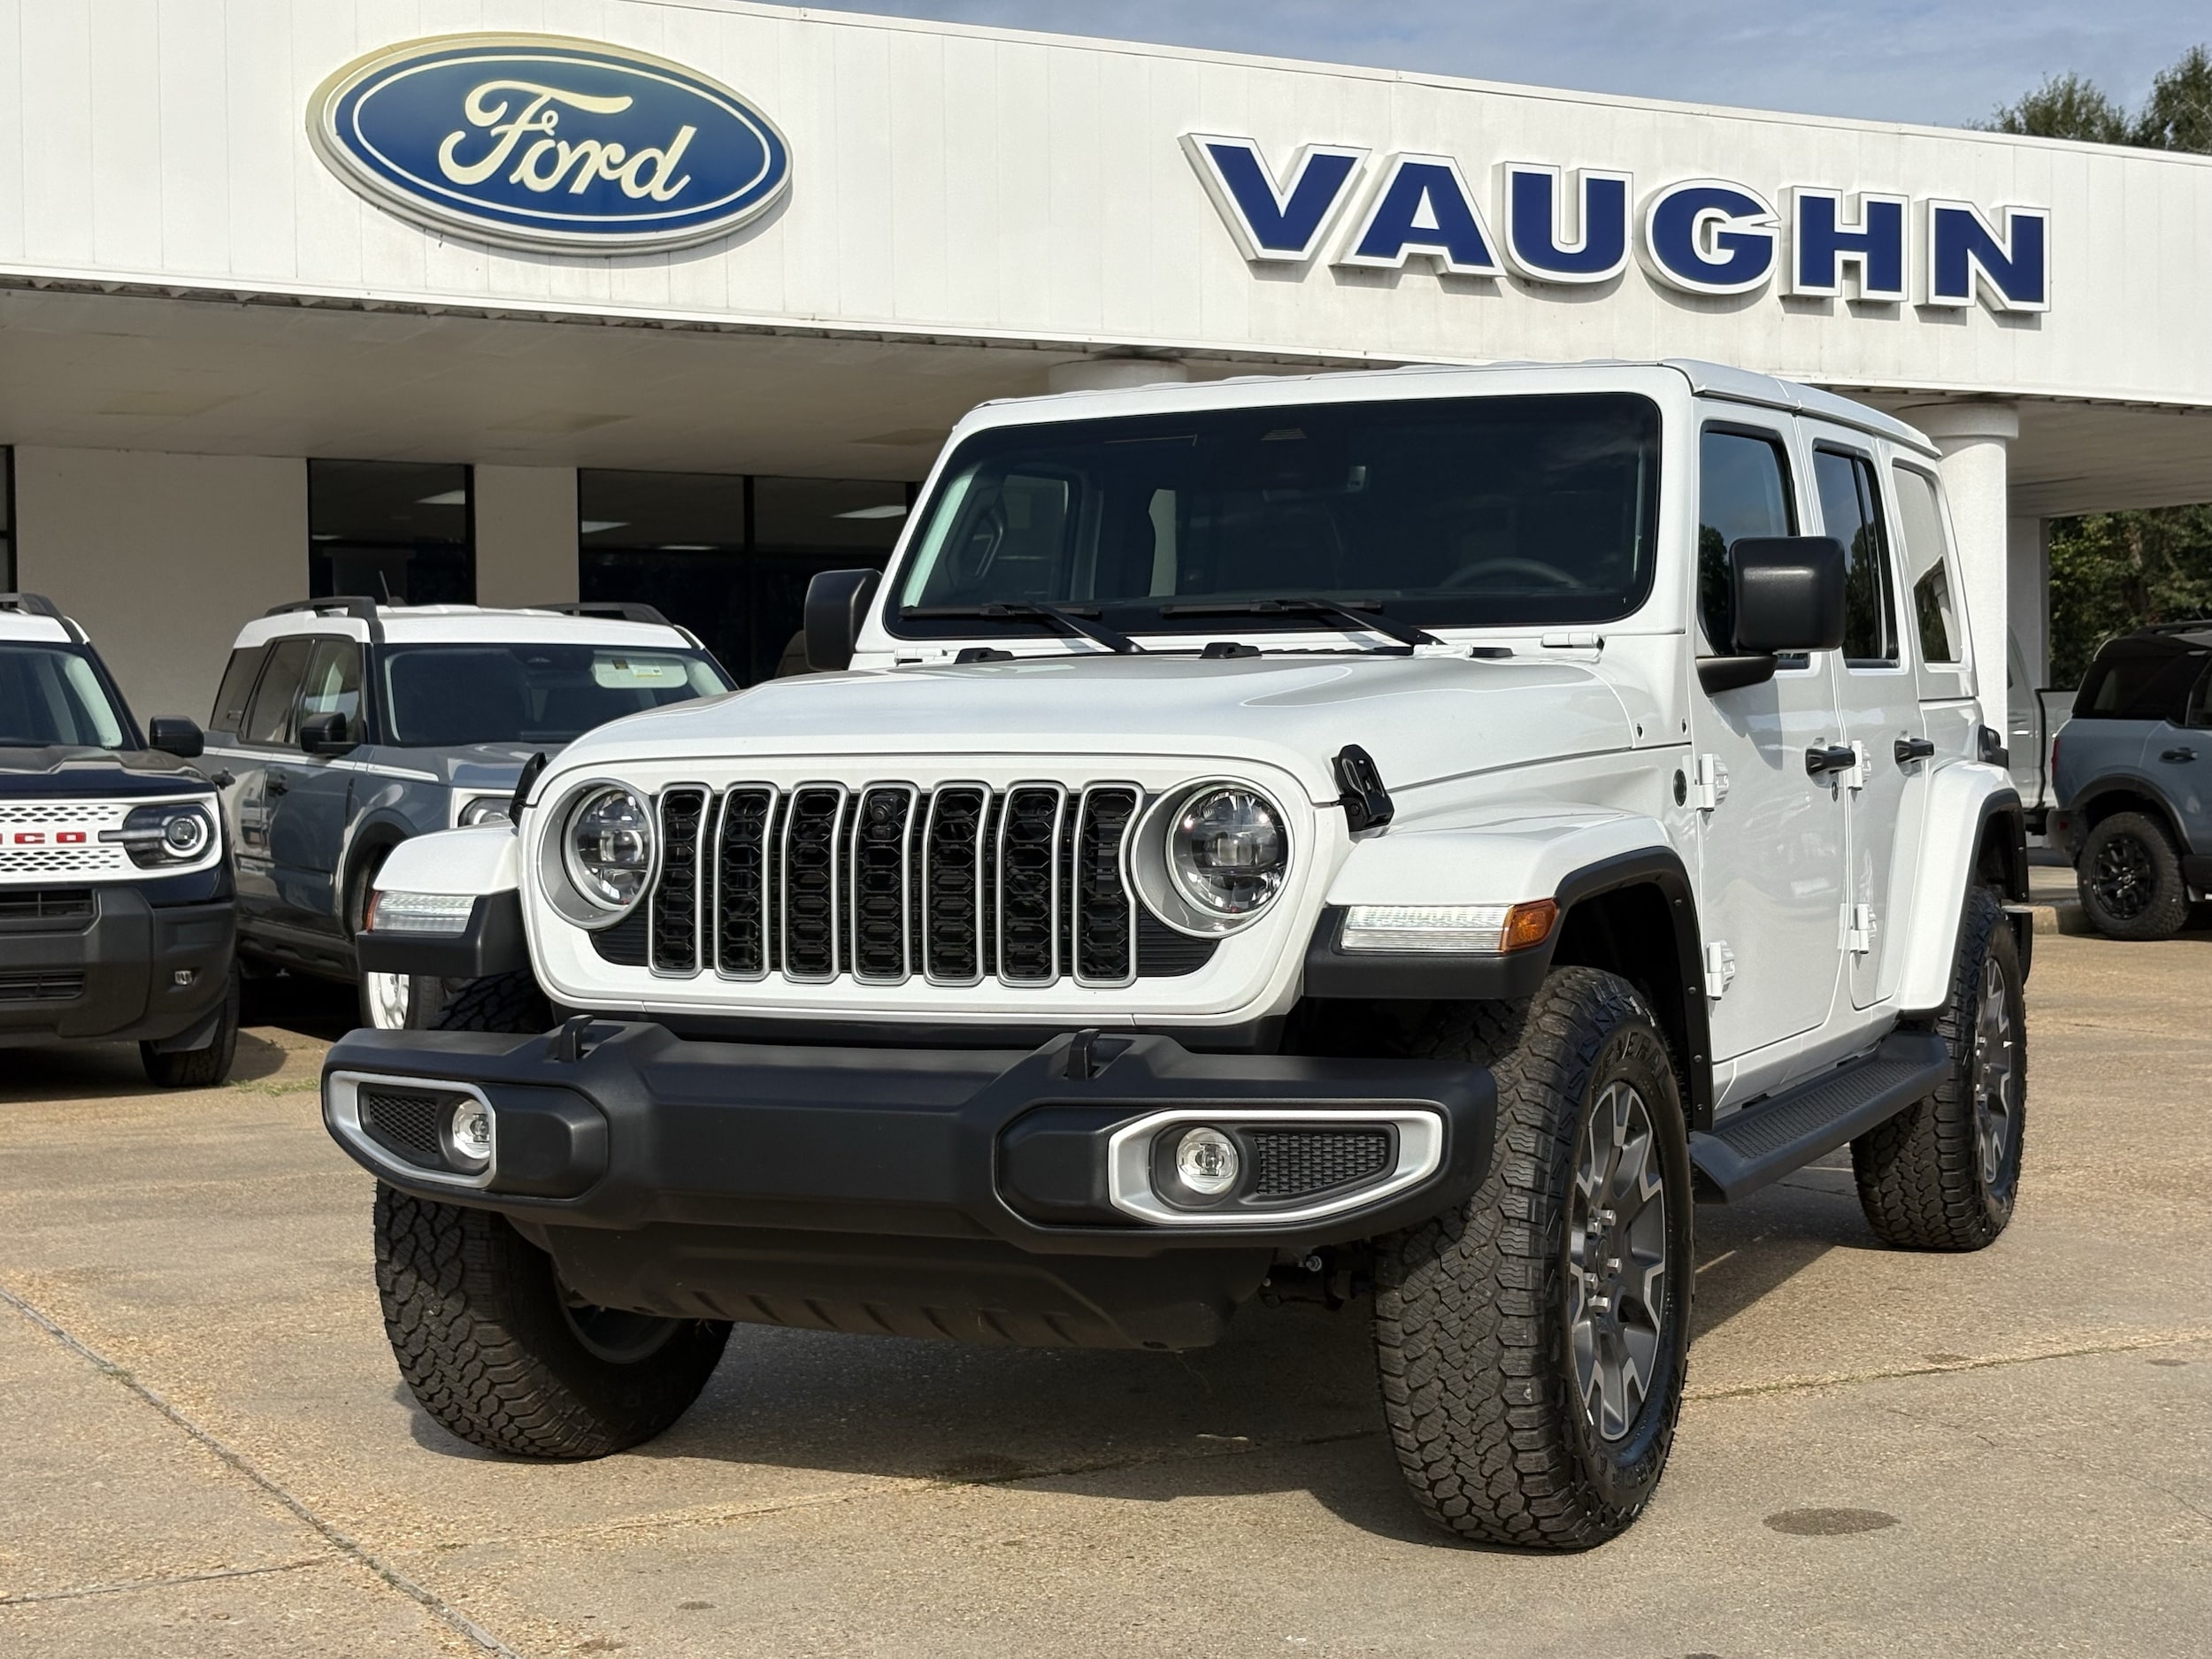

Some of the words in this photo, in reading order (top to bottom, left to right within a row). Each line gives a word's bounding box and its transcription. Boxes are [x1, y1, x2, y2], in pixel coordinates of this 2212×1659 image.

[438, 81, 697, 202] Ford
[1190, 137, 2051, 310] VAUGHN
[0, 832, 87, 845] CO
